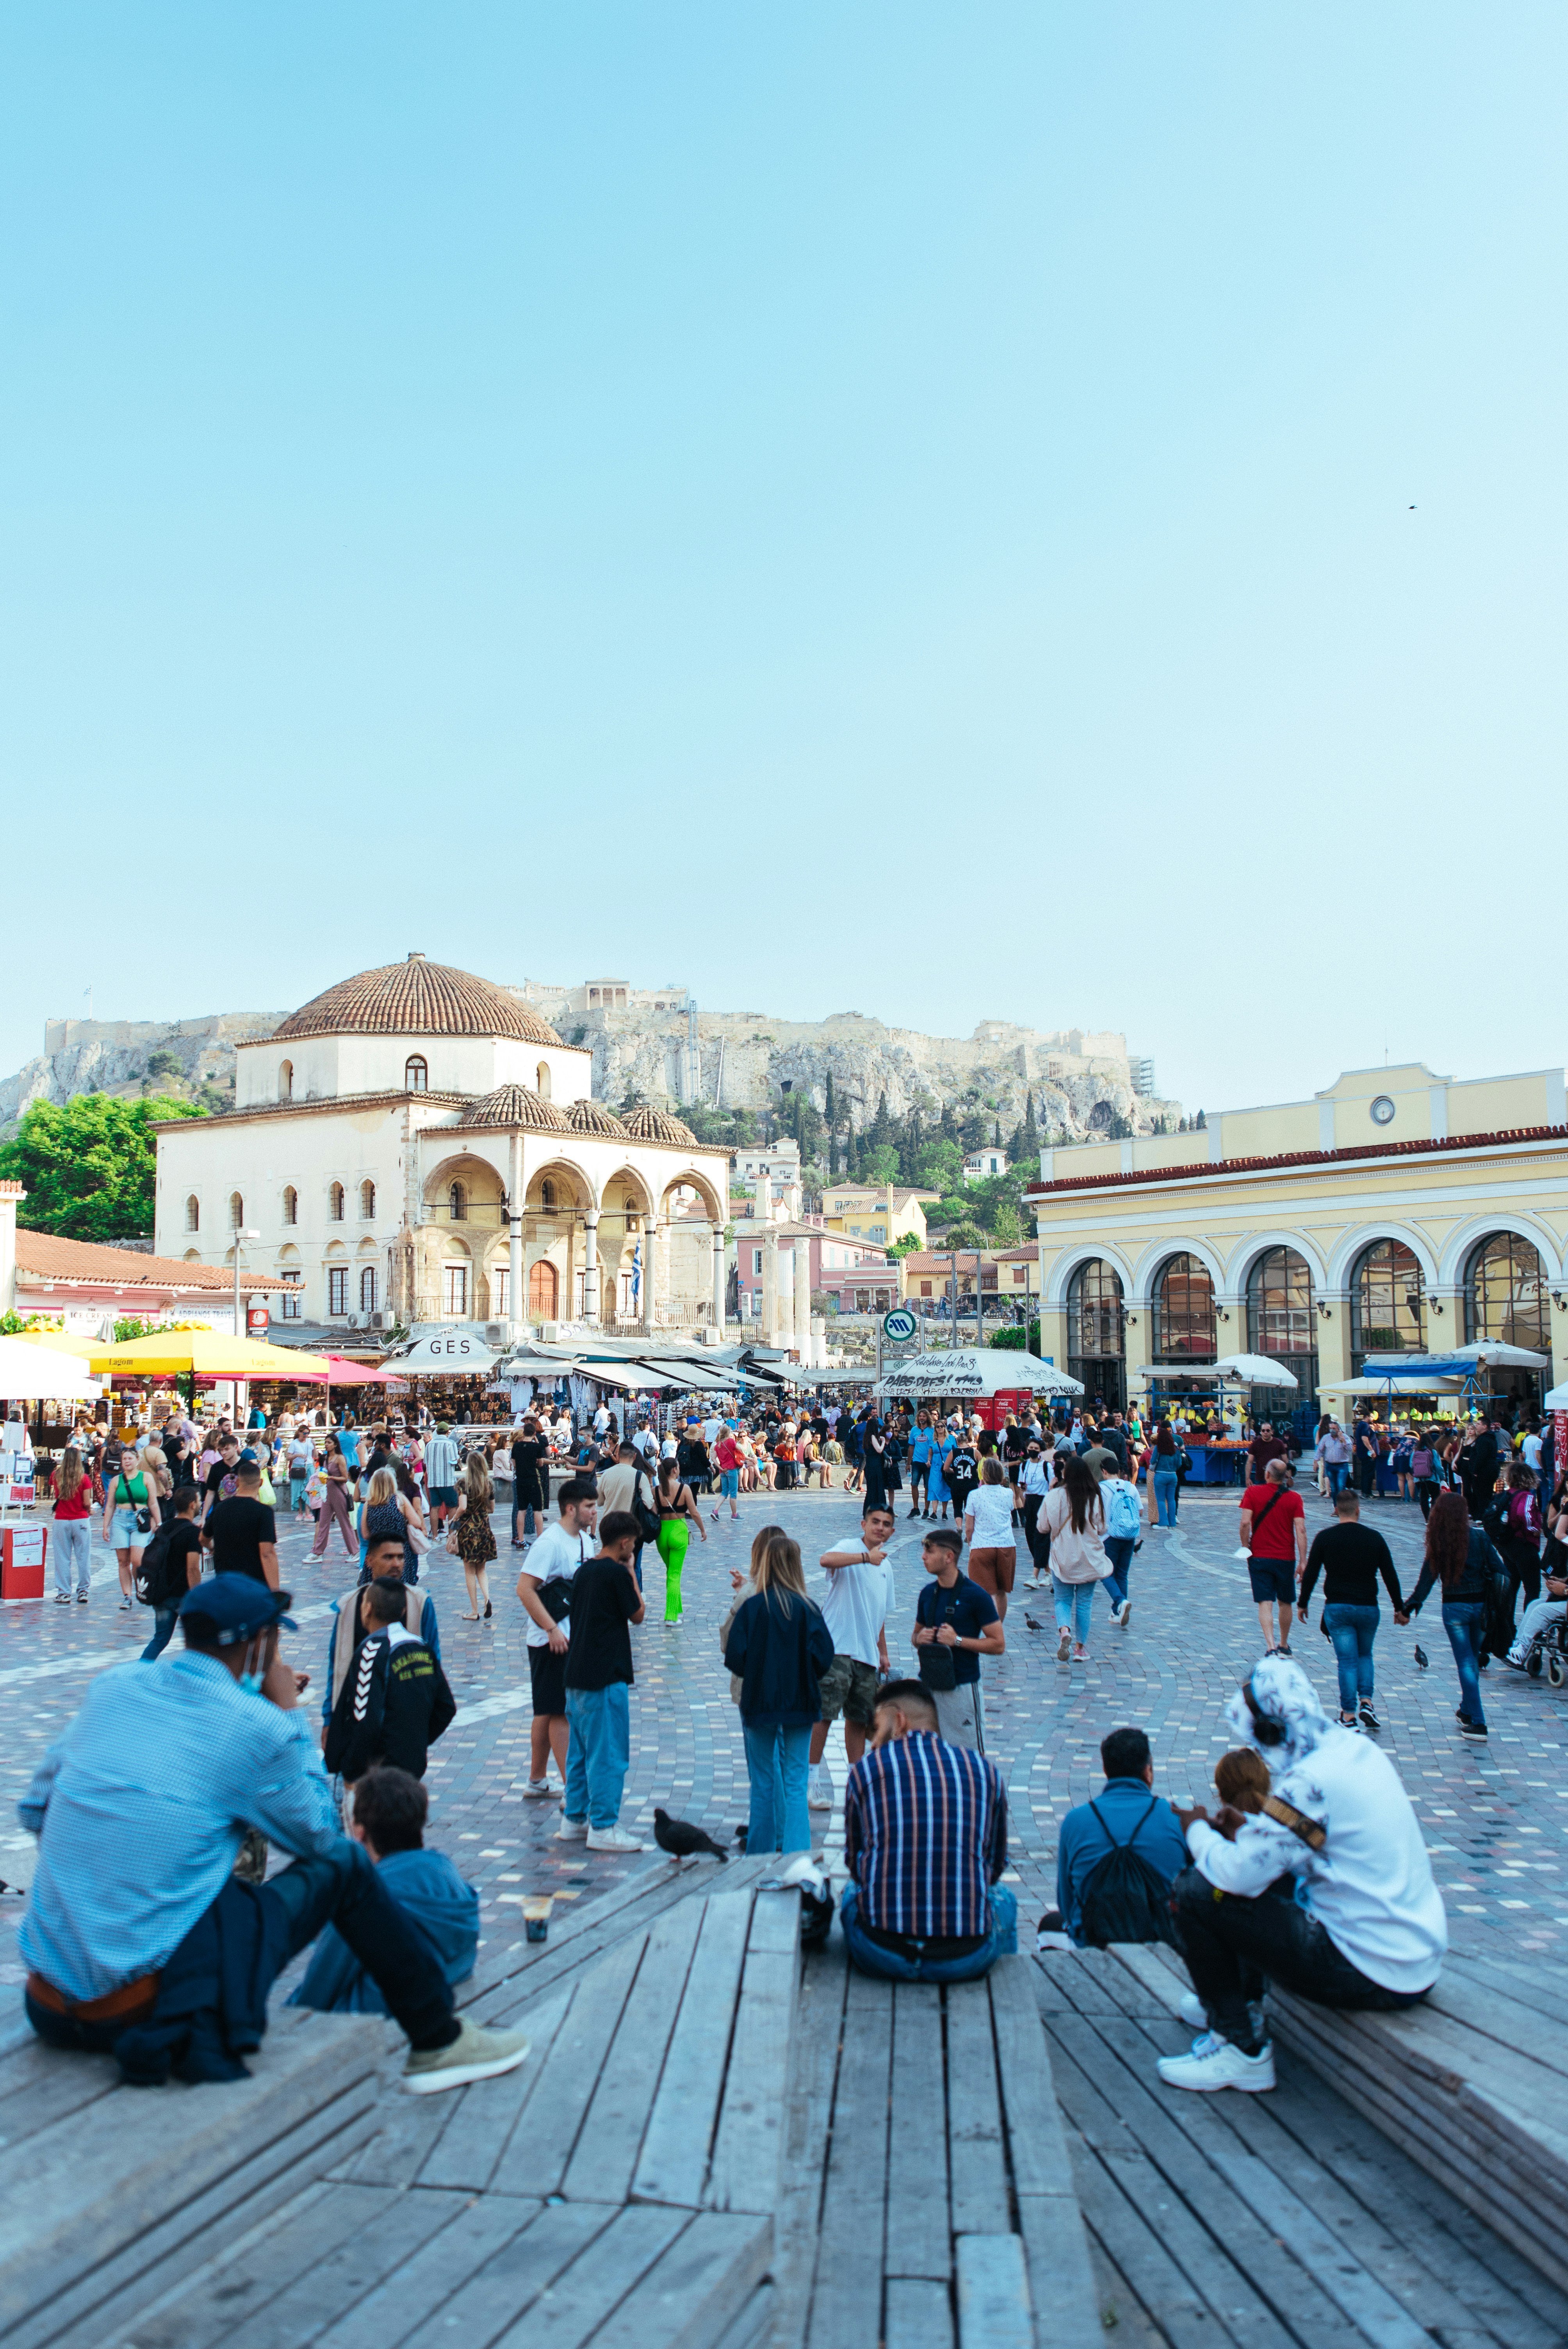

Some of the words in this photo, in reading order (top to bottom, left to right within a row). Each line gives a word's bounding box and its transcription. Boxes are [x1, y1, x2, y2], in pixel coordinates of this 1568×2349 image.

[178, 1310, 210, 1319] ADRIANOS
[430, 1340, 470, 1354] GES
[109, 1358, 133, 1367] Lagom
[251, 1358, 276, 1367] Lagom
[118, 1381, 137, 1389] gelato
[957, 1465, 972, 1479] 34
